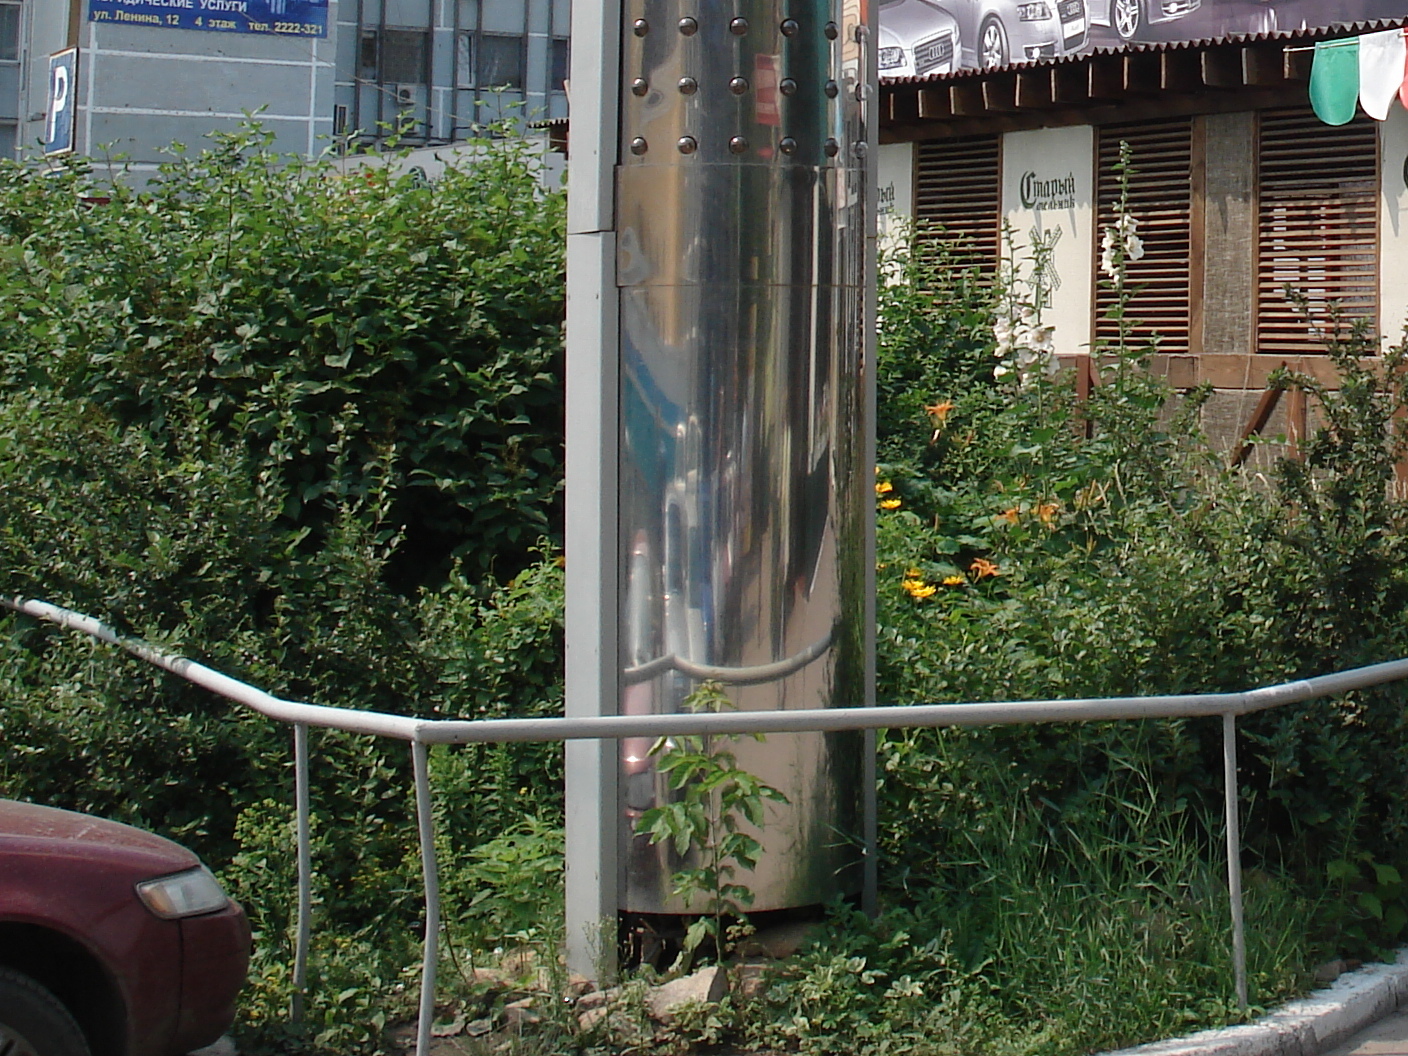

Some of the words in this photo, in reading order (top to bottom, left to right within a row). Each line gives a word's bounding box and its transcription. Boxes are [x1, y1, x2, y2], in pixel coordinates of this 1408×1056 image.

[93, 9, 112, 22] ул.
[114, 8, 163, 27] Ленина,
[166, 13, 180, 26] 12
[195, 16, 203, 27] 4
[208, 18, 237, 30] этаж
[274, 21, 324, 35] 2222-321
[49, 65, 68, 143] P
